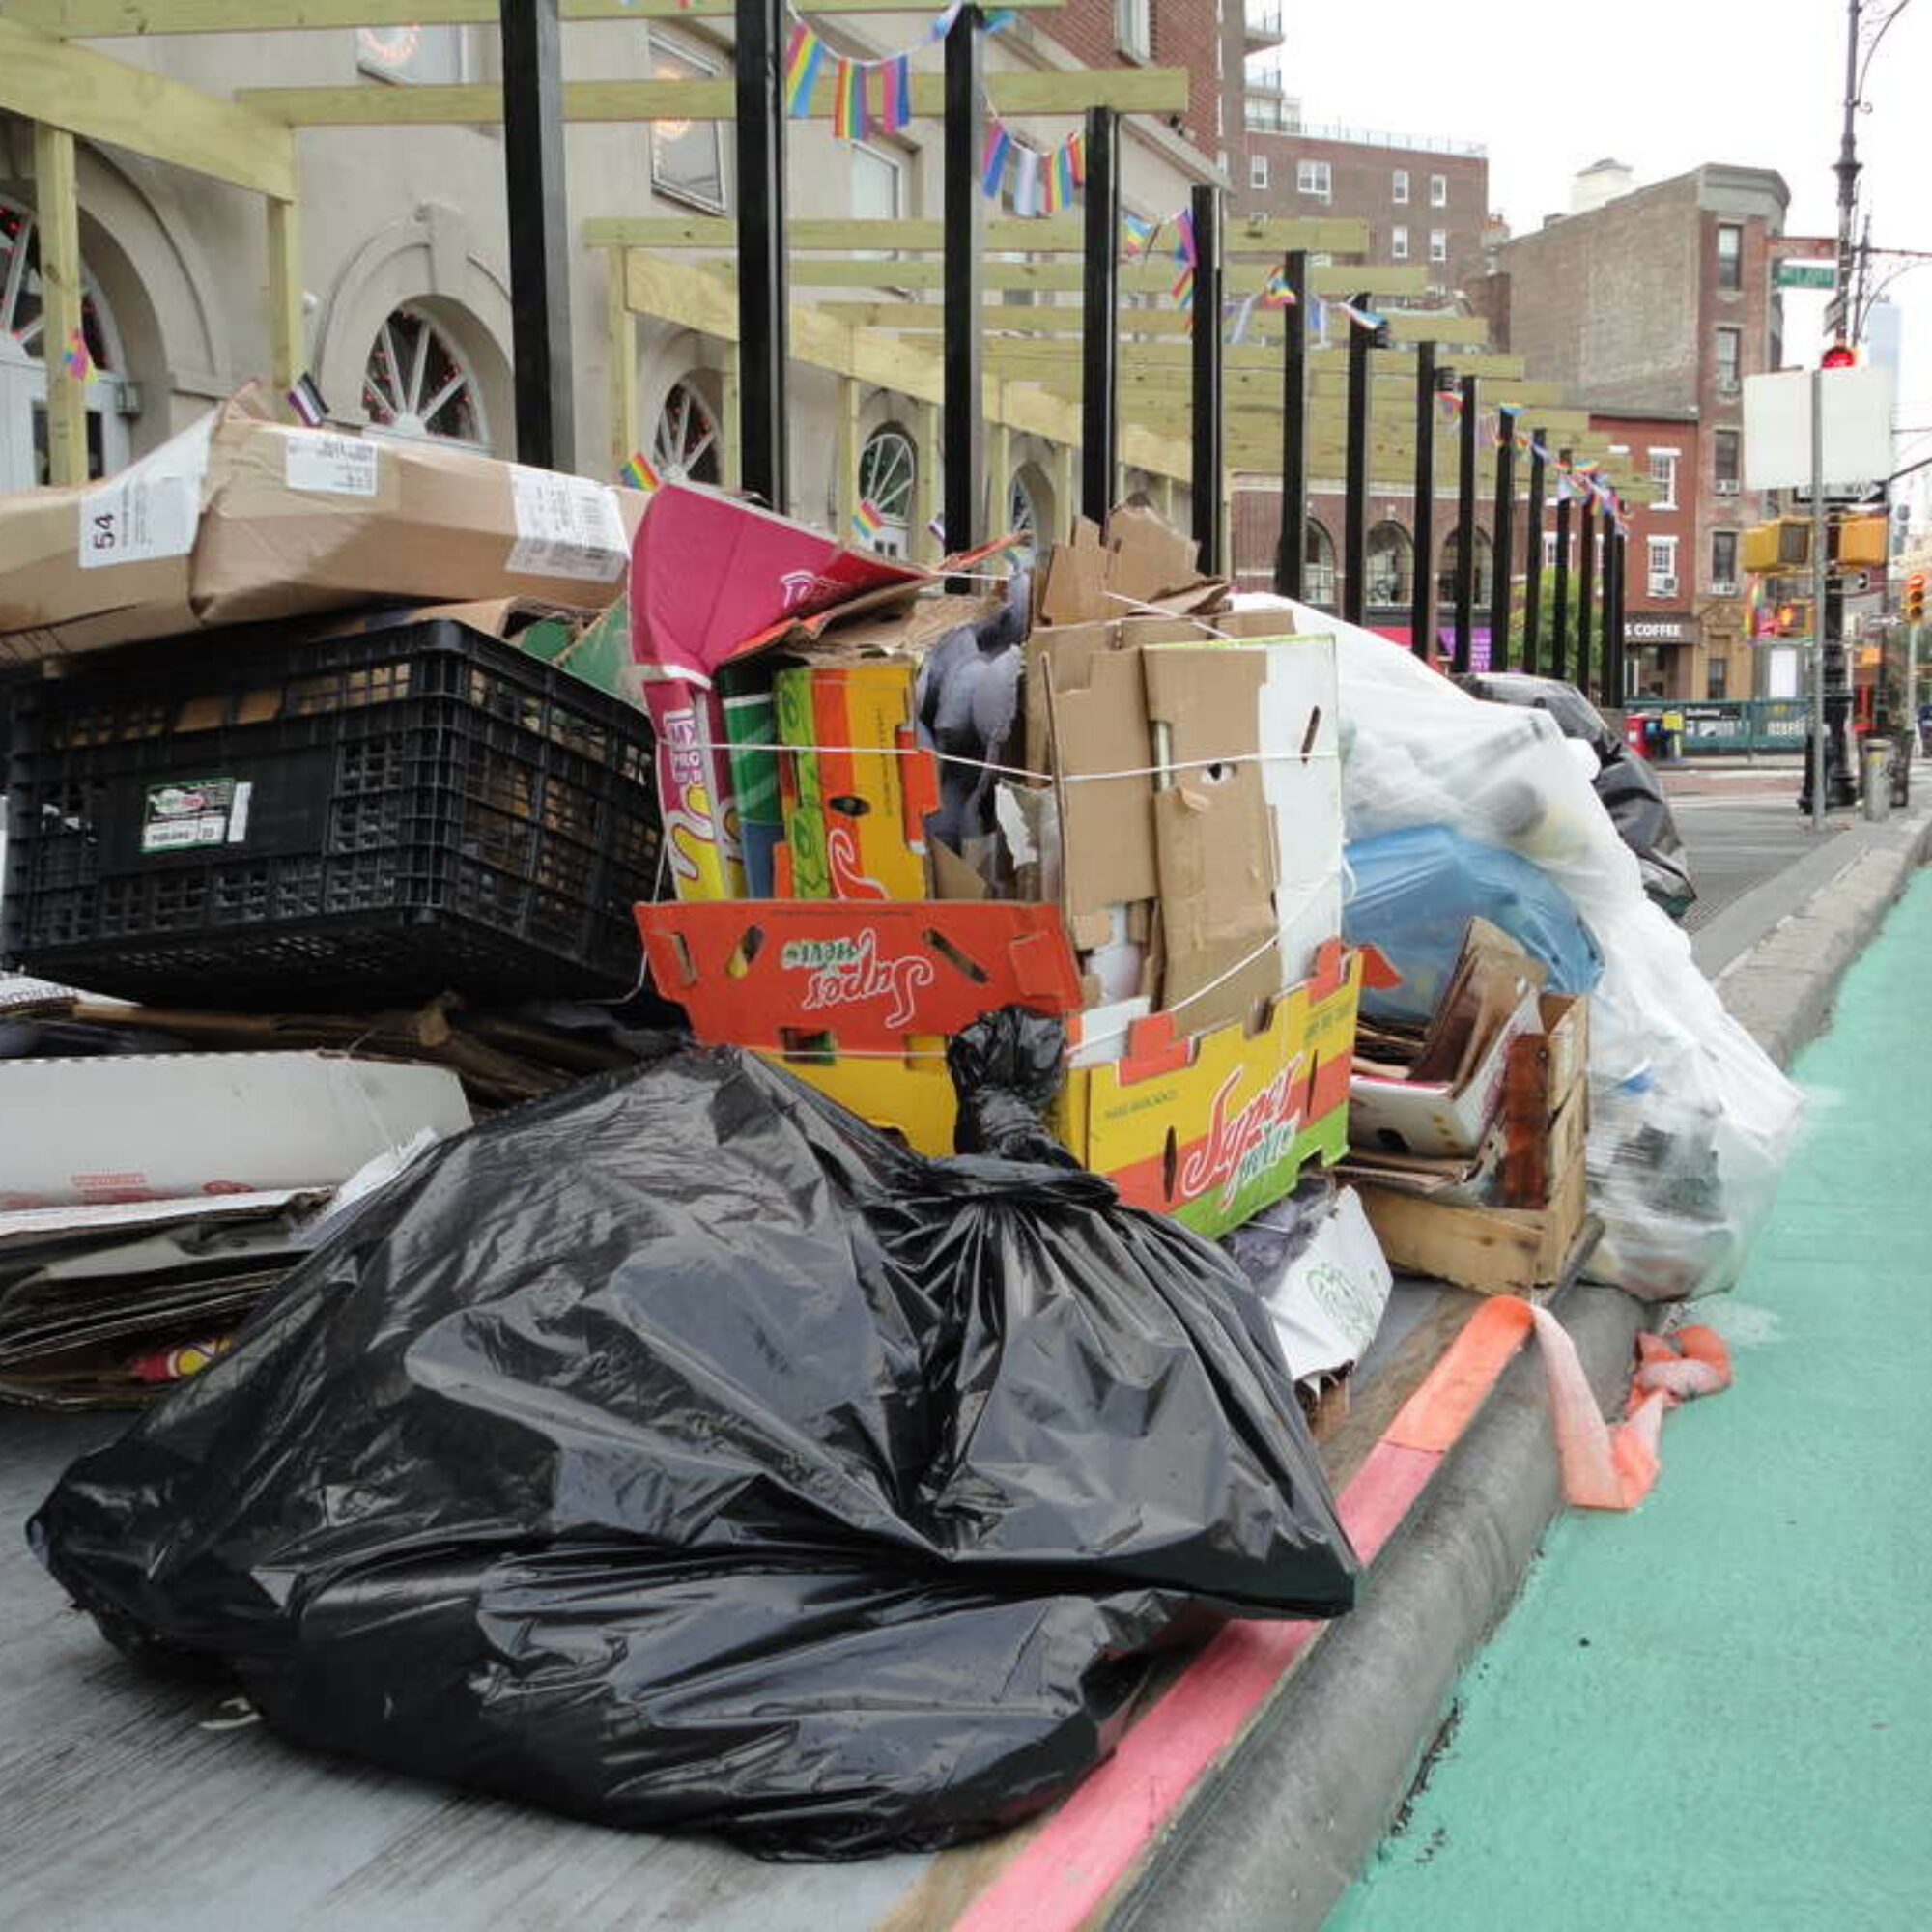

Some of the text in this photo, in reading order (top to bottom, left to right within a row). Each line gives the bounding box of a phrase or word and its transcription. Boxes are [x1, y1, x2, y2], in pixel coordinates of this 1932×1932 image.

[93, 511, 116, 550] 54
[1634, 623, 1682, 637] COFFEE
[801, 927, 934, 1030] Super
[1181, 1049, 1303, 1215] Super
